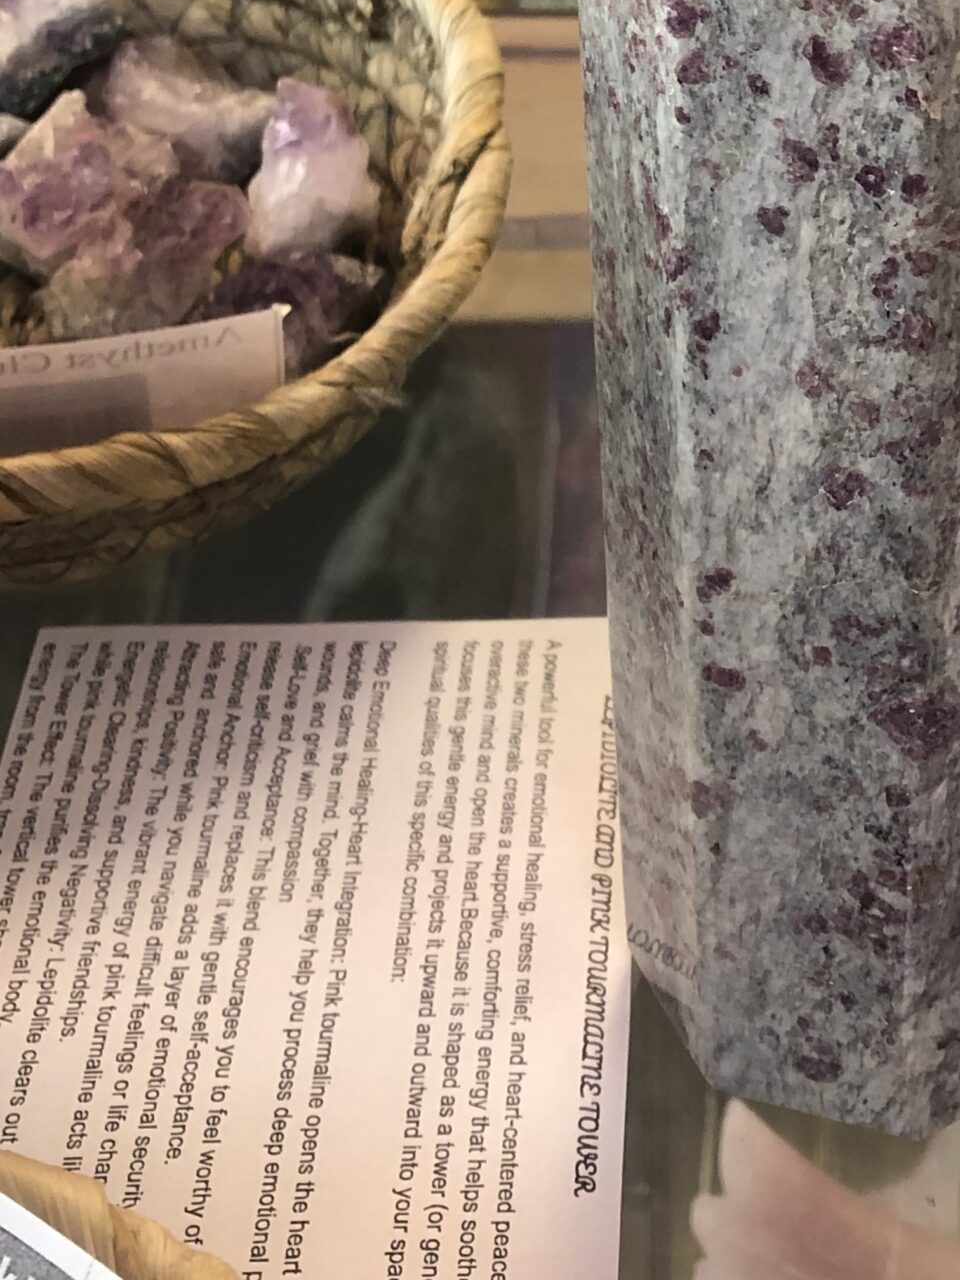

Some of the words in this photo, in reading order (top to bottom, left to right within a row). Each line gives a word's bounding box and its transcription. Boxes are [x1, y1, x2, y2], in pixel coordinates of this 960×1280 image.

[429, 641, 449, 692] spiritual
[457, 641, 480, 692] focuses
[515, 640, 534, 677] these
[546, 640, 563, 651] A
[483, 640, 505, 710] overactive
[512, 681, 530, 706] two
[540, 654, 559, 713] powerful
[419, 696, 442, 757] qualities
[453, 696, 472, 722] this
[537, 717, 555, 744] tool
[302, 733, 321, 767] grief
[447, 726, 466, 772] gentle
[478, 715, 496, 750] mind
[505, 710, 525, 773] minerals
[113, 738, 149, 810] kindness,
[329, 752, 349, 776] the
[418, 761, 436, 776] of
[474, 754, 492, 783] and
[535, 748, 554, 769] for
[28, 772, 54, 802] The
[144, 785, 169, 816] The
[173, 782, 195, 822] while
[206, 776, 229, 810] Pink
[233, 791, 252, 820] and
[259, 746, 293, 840] Acceptance:
[297, 771, 314, 801] with
[322, 781, 342, 823] mind.
[413, 780, 434, 808] this
[436, 776, 460, 830] energy
[469, 787, 488, 827] open
[499, 777, 518, 835] creates
[43, 798, 72, 855] purifies
[107, 815, 128, 844] and
[345, 758, 378, 866] Healing-Heart
[528, 773, 548, 848] emotional
[11, 807, 40, 863] vertical
[130, 820, 158, 875] vibrant
[165, 827, 184, 856] you
[186, 814, 219, 898] tourmaline
[278, 806, 308, 902] compassion
[405, 812, 426, 872] specific
[436, 834, 454, 864] and
[467, 832, 487, 855] the
[498, 839, 512, 849] a
[593, 824, 616, 868] AND
[36, 860, 59, 885] the
[218, 825, 245, 893] replaces
[251, 846, 276, 881] This
[306, 829, 339, 902] Together,
[0, 867, 26, 914] tower
[46, 864, 89, 951] Negativity:
[85, 850, 119, 935] supportive
[148, 861, 177, 931] navigate
[215, 899, 235, 908] it
[427, 869, 450, 934] projects
[485, 854, 511, 943] supportive,
[517, 853, 544, 916] healing,
[590, 873, 613, 933] PINK
[112, 879, 142, 937] energy
[176, 904, 200, 944] adds
[208, 912, 229, 946] with
[242, 886, 269, 931] blend
[298, 908, 325, 944] they
[330, 871, 361, 963] Integration:
[391, 876, 418, 982] combination:
[453, 861, 483, 981] heart.Because
[11, 890, 47, 974] emotional
[112, 942, 130, 959] of
[174, 950, 189, 960] a
[425, 939, 446, 949] it
[517, 922, 537, 973] stress
[101, 964, 126, 1001] pink
[133, 936, 164, 998] difficult
[163, 966, 190, 1010] layer
[196, 951, 220, 1005] gentle
[221, 937, 254, 1039] encourages
[292, 949, 319, 985] help
[323, 969, 348, 1007] Pink
[417, 954, 438, 1017] upward
[26, 958, 65, 1043] Lepidolite
[59, 941, 102, 1042] friendships.
[288, 990, 309, 1022] you
[449, 1003, 469, 1016] is
[451, 987, 472, 998] it
[474, 949, 503, 1040] comforting
[510, 979, 534, 1025] relief,
[115, 1003, 150, 1074] feelings
[159, 1015, 178, 1032] of
[413, 1024, 432, 1056] and
[579, 936, 609, 1098] TOURMALINE
[77, 1006, 117, 1103] tourmaline
[214, 1045, 235, 1078] you
[276, 1029, 302, 1101] process
[308, 1012, 340, 1108] tourmaline
[441, 1022, 466, 1088] shaped
[509, 1032, 527, 1065] and
[9, 1050, 39, 1106] clears
[111, 1080, 130, 1099] or
[138, 1038, 171, 1129] emotional
[164, 1011, 210, 1164] self-acceptance.
[210, 1085, 230, 1102] to
[403, 1063, 427, 1138] outward
[468, 1047, 492, 1110] energy
[0, 1113, 21, 1144] out
[66, 1110, 89, 1149] acts
[104, 1105, 129, 1132] life
[202, 1109, 228, 1143] feel
[436, 1124, 453, 1135] a
[438, 1096, 456, 1117] as
[263, 1107, 293, 1155] deep
[297, 1115, 321, 1174] opens
[468, 1116, 490, 1153] that
[496, 1072, 526, 1213] heart-centered
[573, 1102, 601, 1197] TOWER
[183, 1150, 216, 1218] worthy
[398, 1146, 421, 1181] into
[430, 1142, 455, 1198] tower
[460, 1160, 487, 1213] helps
[249, 1163, 280, 1262] emotional
[291, 1181, 315, 1213] the
[392, 1188, 412, 1233] your
[423, 1204, 450, 1232] (or
[183, 1225, 204, 1245] of
[282, 1220, 310, 1275] heart
[456, 1220, 477, 1280] sooth
[384, 1240, 406, 1280] spa
[419, 1239, 441, 1280] gen
